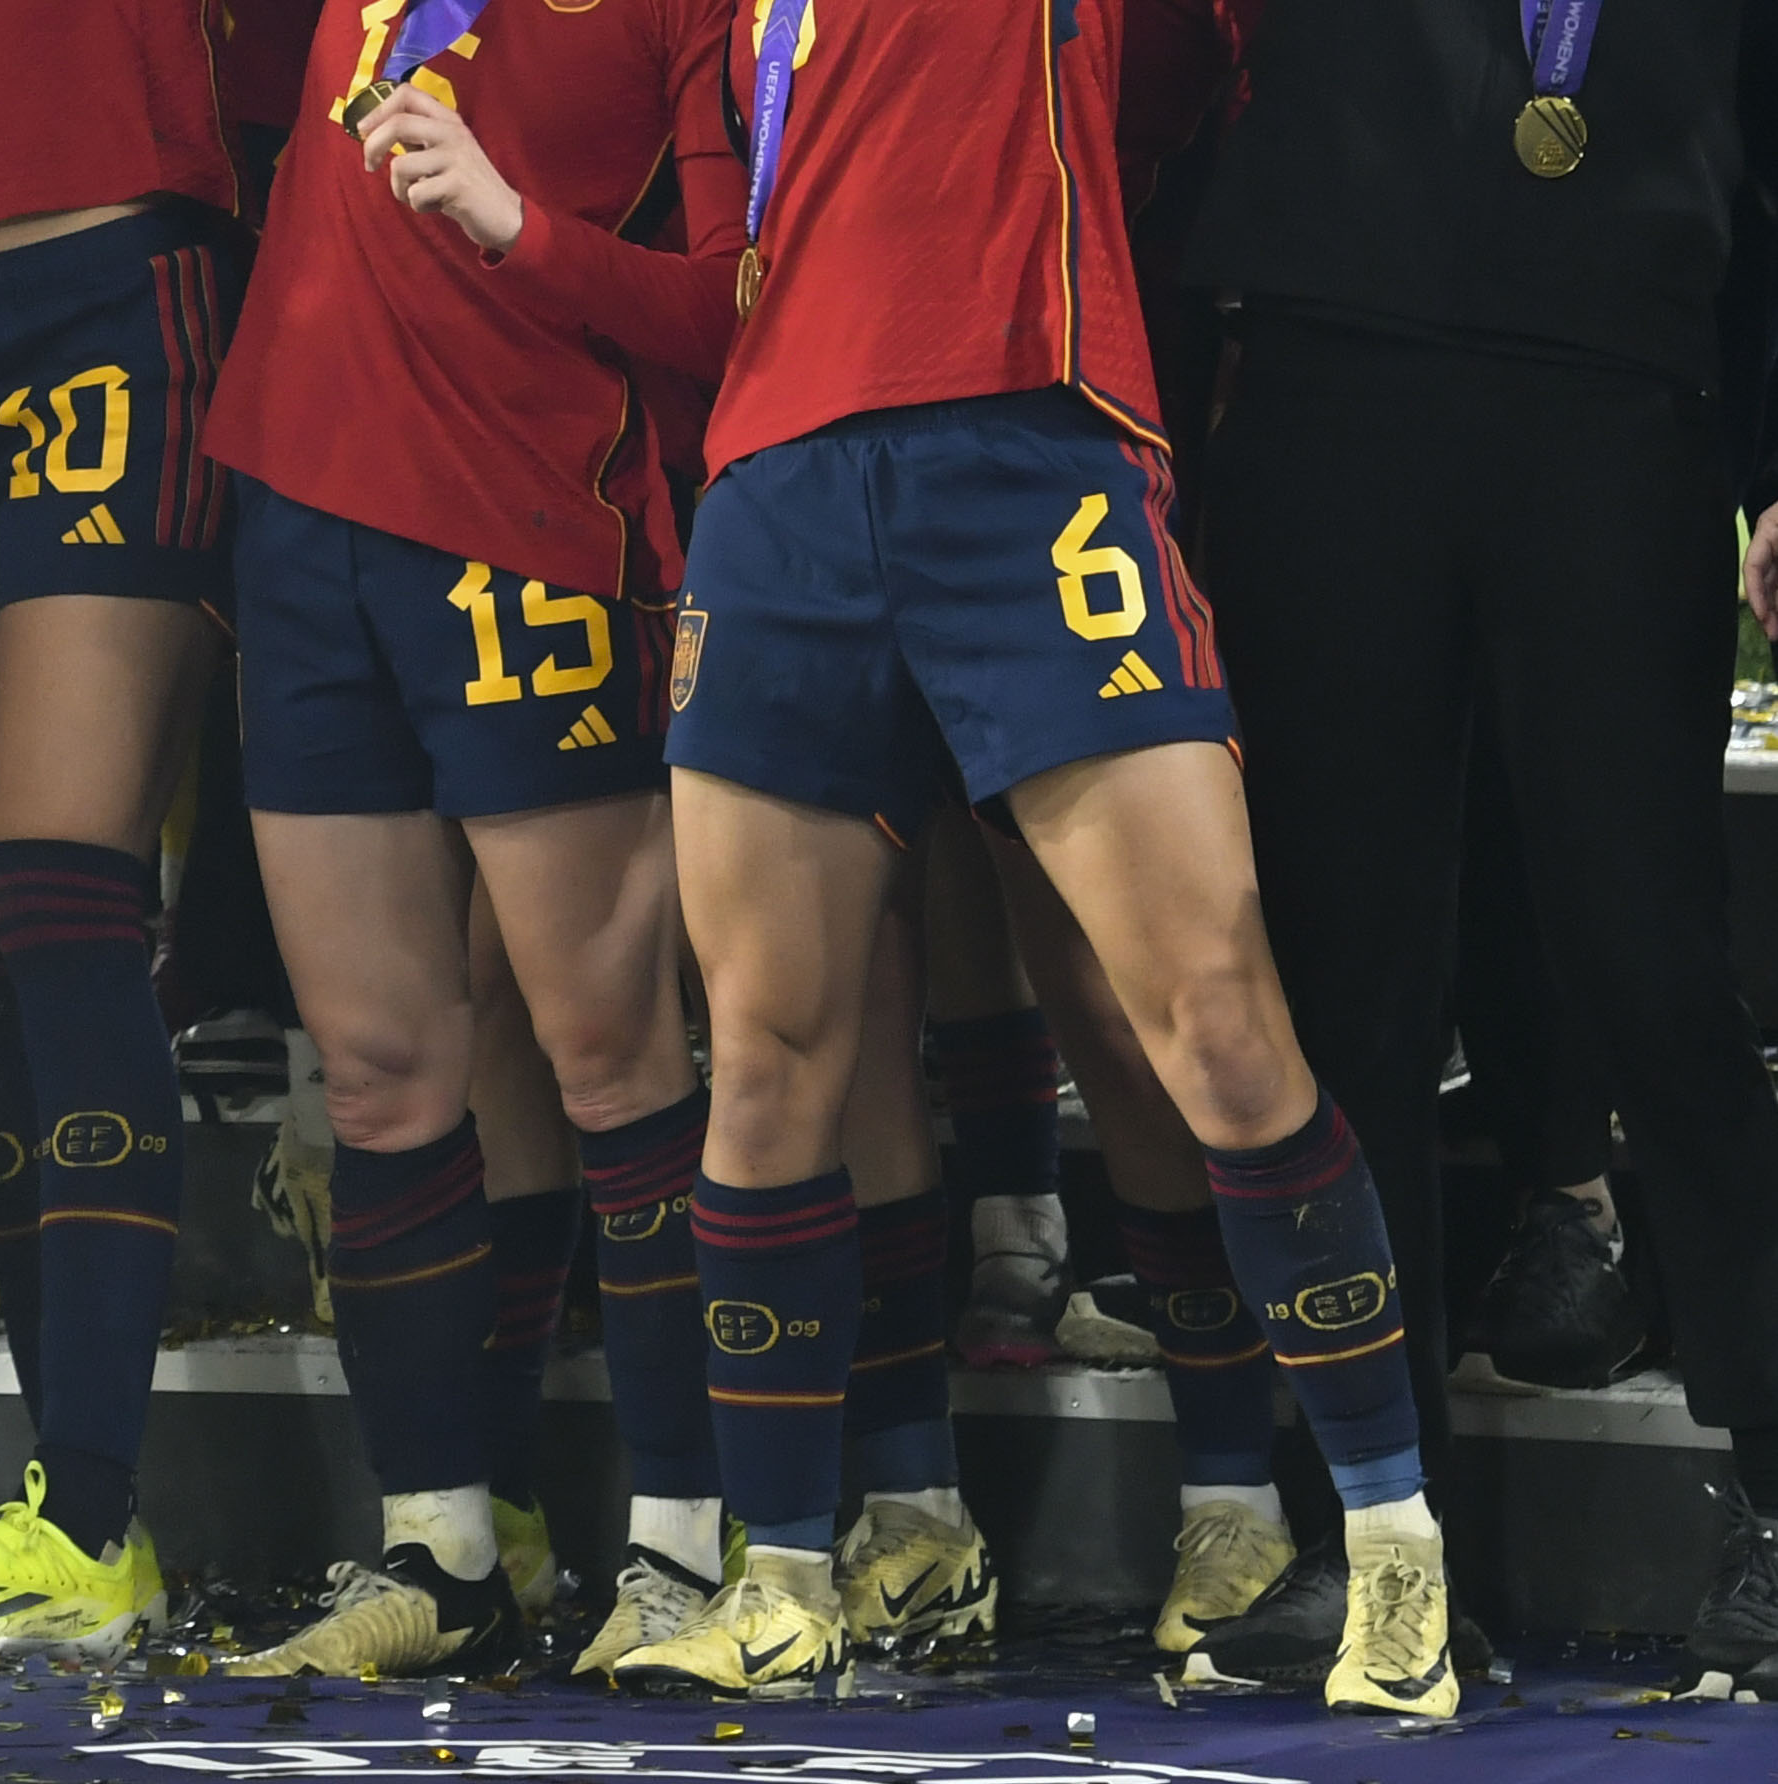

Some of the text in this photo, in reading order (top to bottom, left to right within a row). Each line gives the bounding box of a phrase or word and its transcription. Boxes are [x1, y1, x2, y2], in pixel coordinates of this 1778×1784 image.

[763, 60, 781, 107] UEFA
[1050, 492, 1148, 643] 6
[447, 560, 614, 707] 15
[139, 1134, 167, 1154] 09
[1264, 1301, 1291, 1321] 19
[786, 1319, 821, 1339] 09
